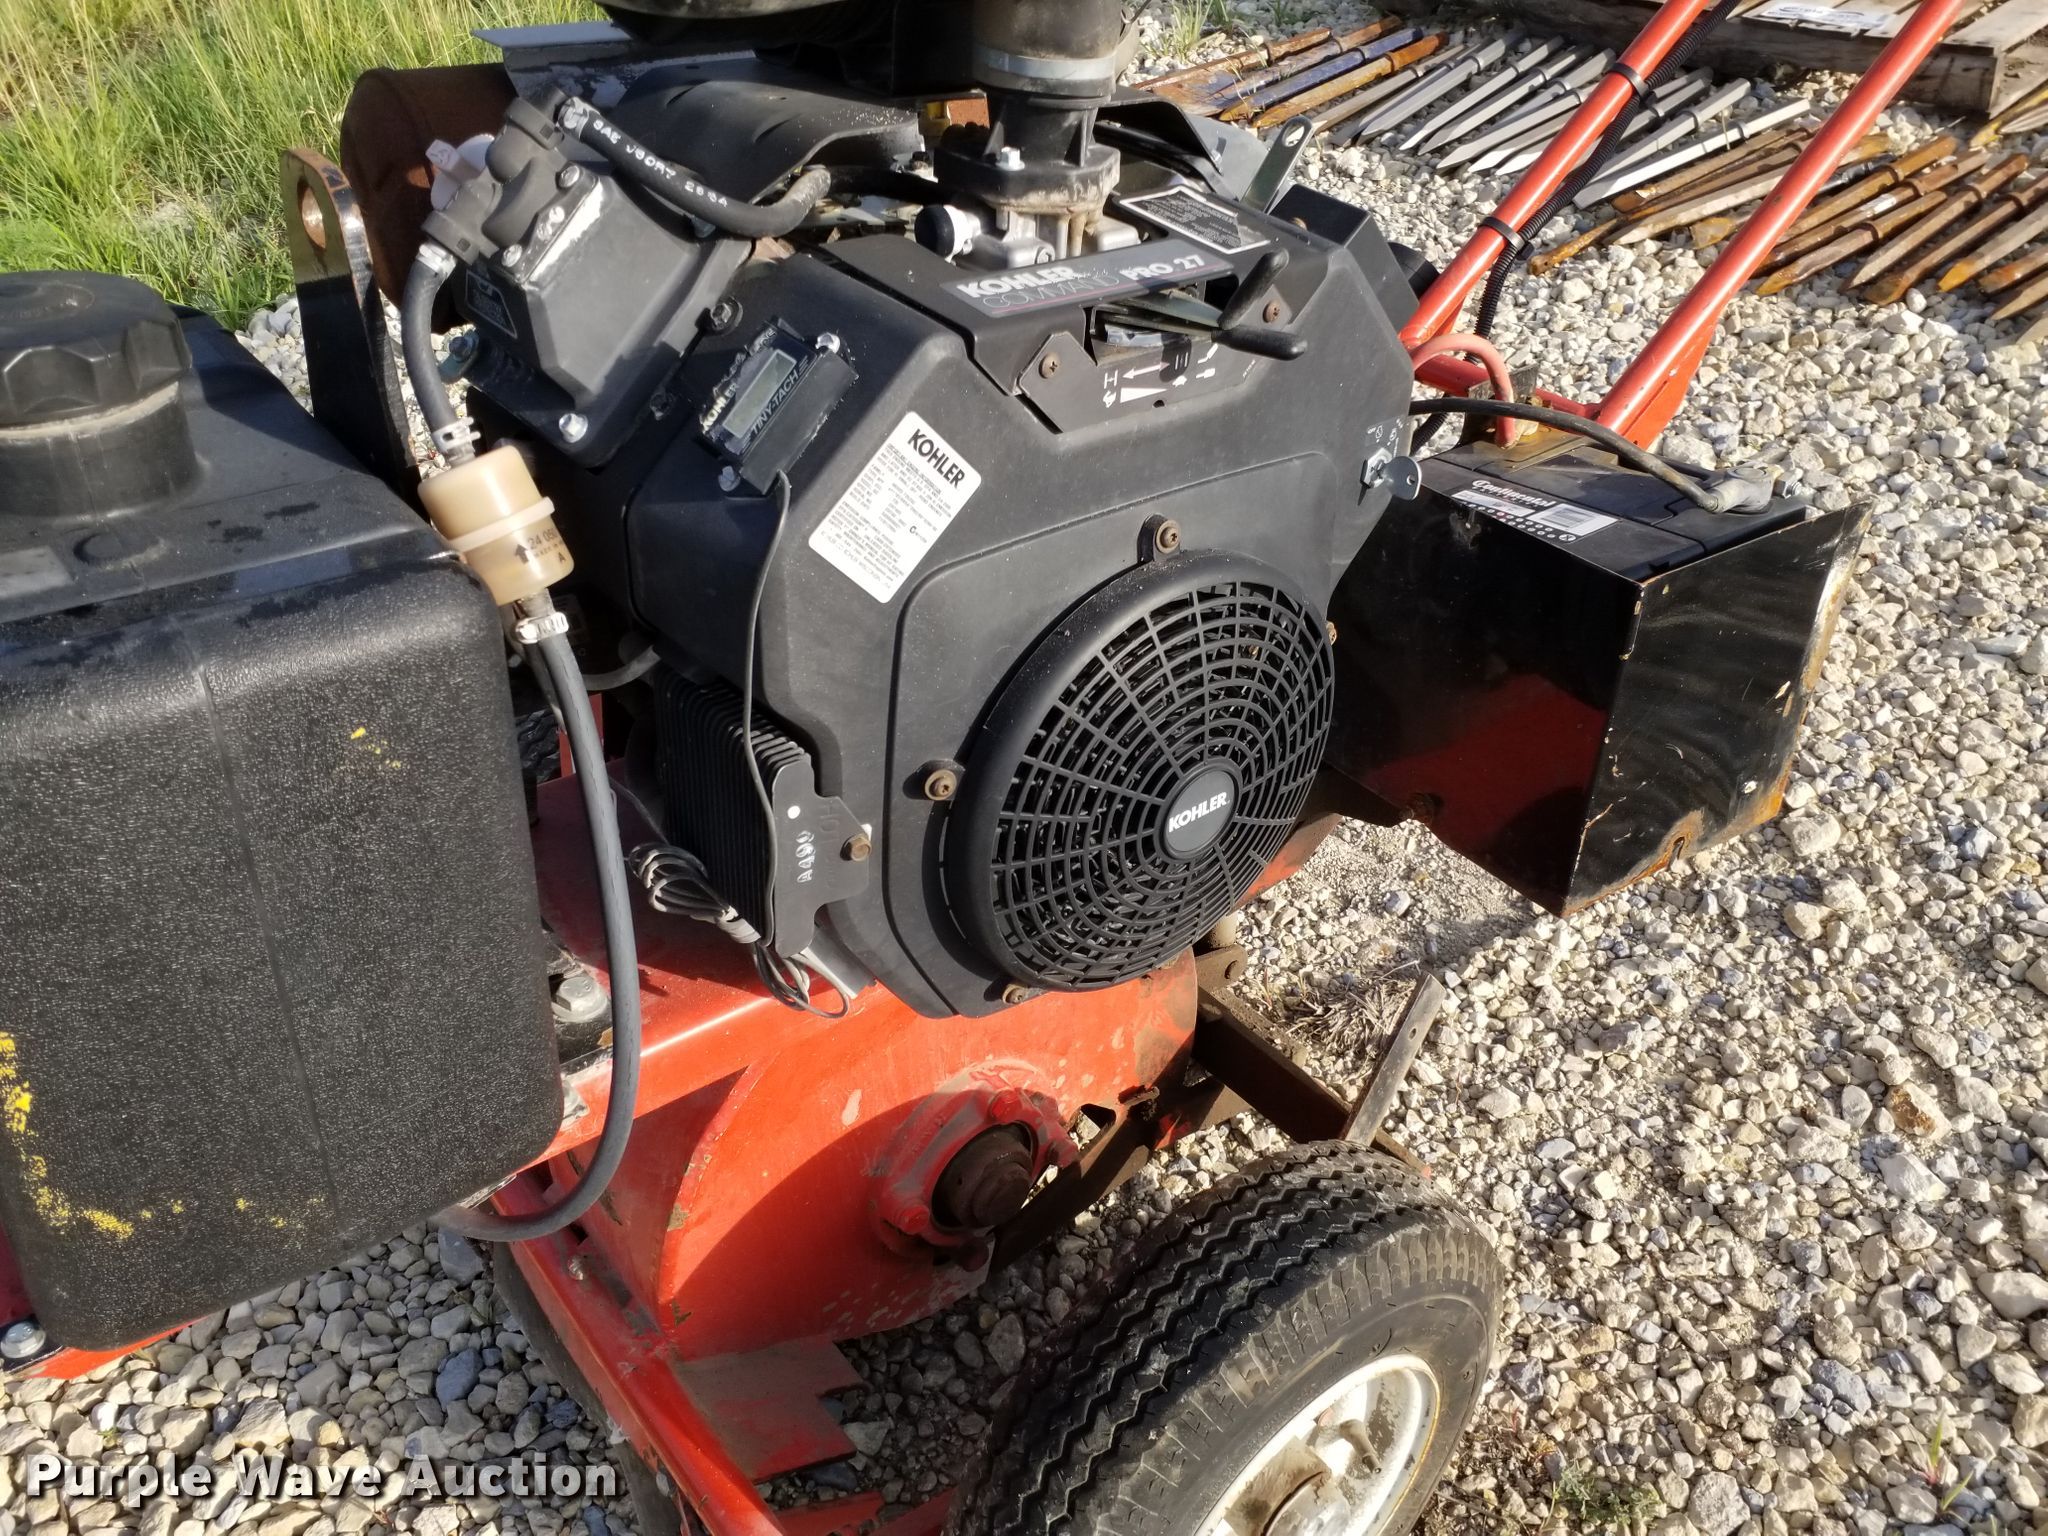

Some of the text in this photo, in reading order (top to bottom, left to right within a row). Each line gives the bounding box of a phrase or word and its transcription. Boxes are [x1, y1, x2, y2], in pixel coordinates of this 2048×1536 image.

[593, 119, 620, 144] SAE
[957, 266, 1075, 298] KOHLER
[1119, 262, 1173, 281] PRO
[1173, 254, 1206, 270] 27
[750, 369, 799, 434] TINY-TACH
[908, 429, 966, 489] KOHLER
[1472, 480, 1557, 507] Continental
[528, 535, 543, 550] 24
[1168, 792, 1227, 833] KOHLER
